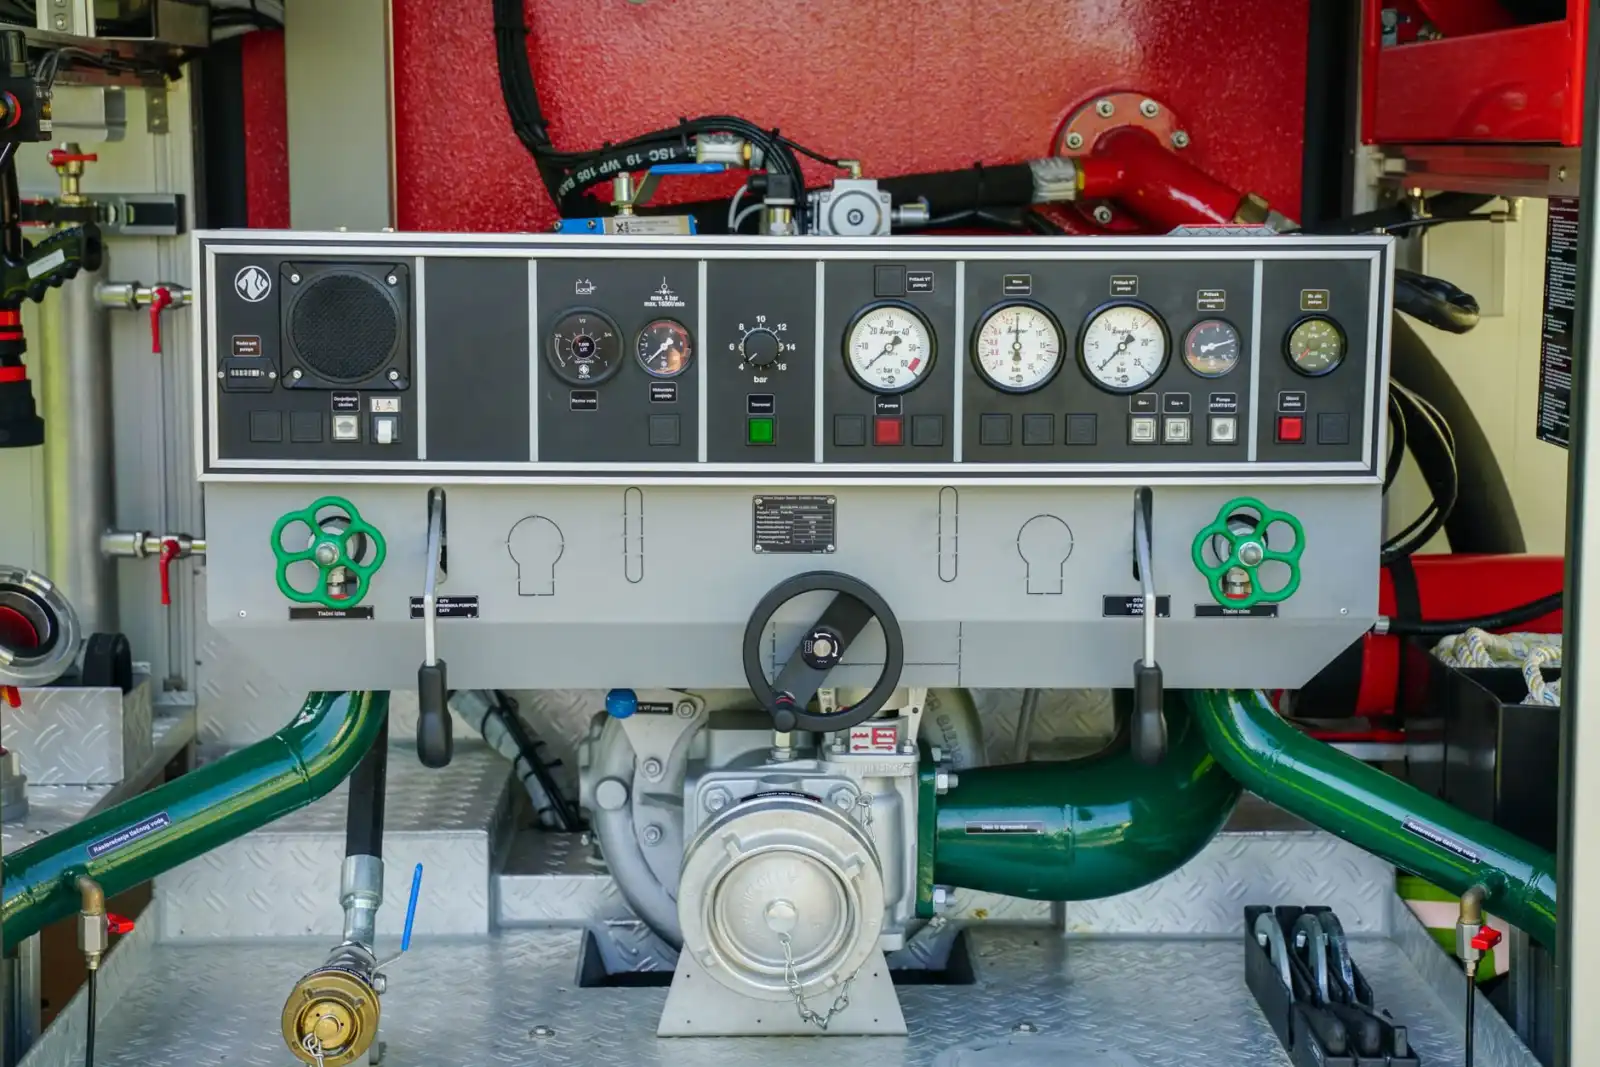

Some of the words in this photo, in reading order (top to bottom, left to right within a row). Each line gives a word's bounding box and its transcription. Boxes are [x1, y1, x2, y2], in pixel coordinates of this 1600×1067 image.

[626, 153, 642, 166] 19
[649, 148, 676, 161] 1SC
[600, 159, 621, 174] WP
